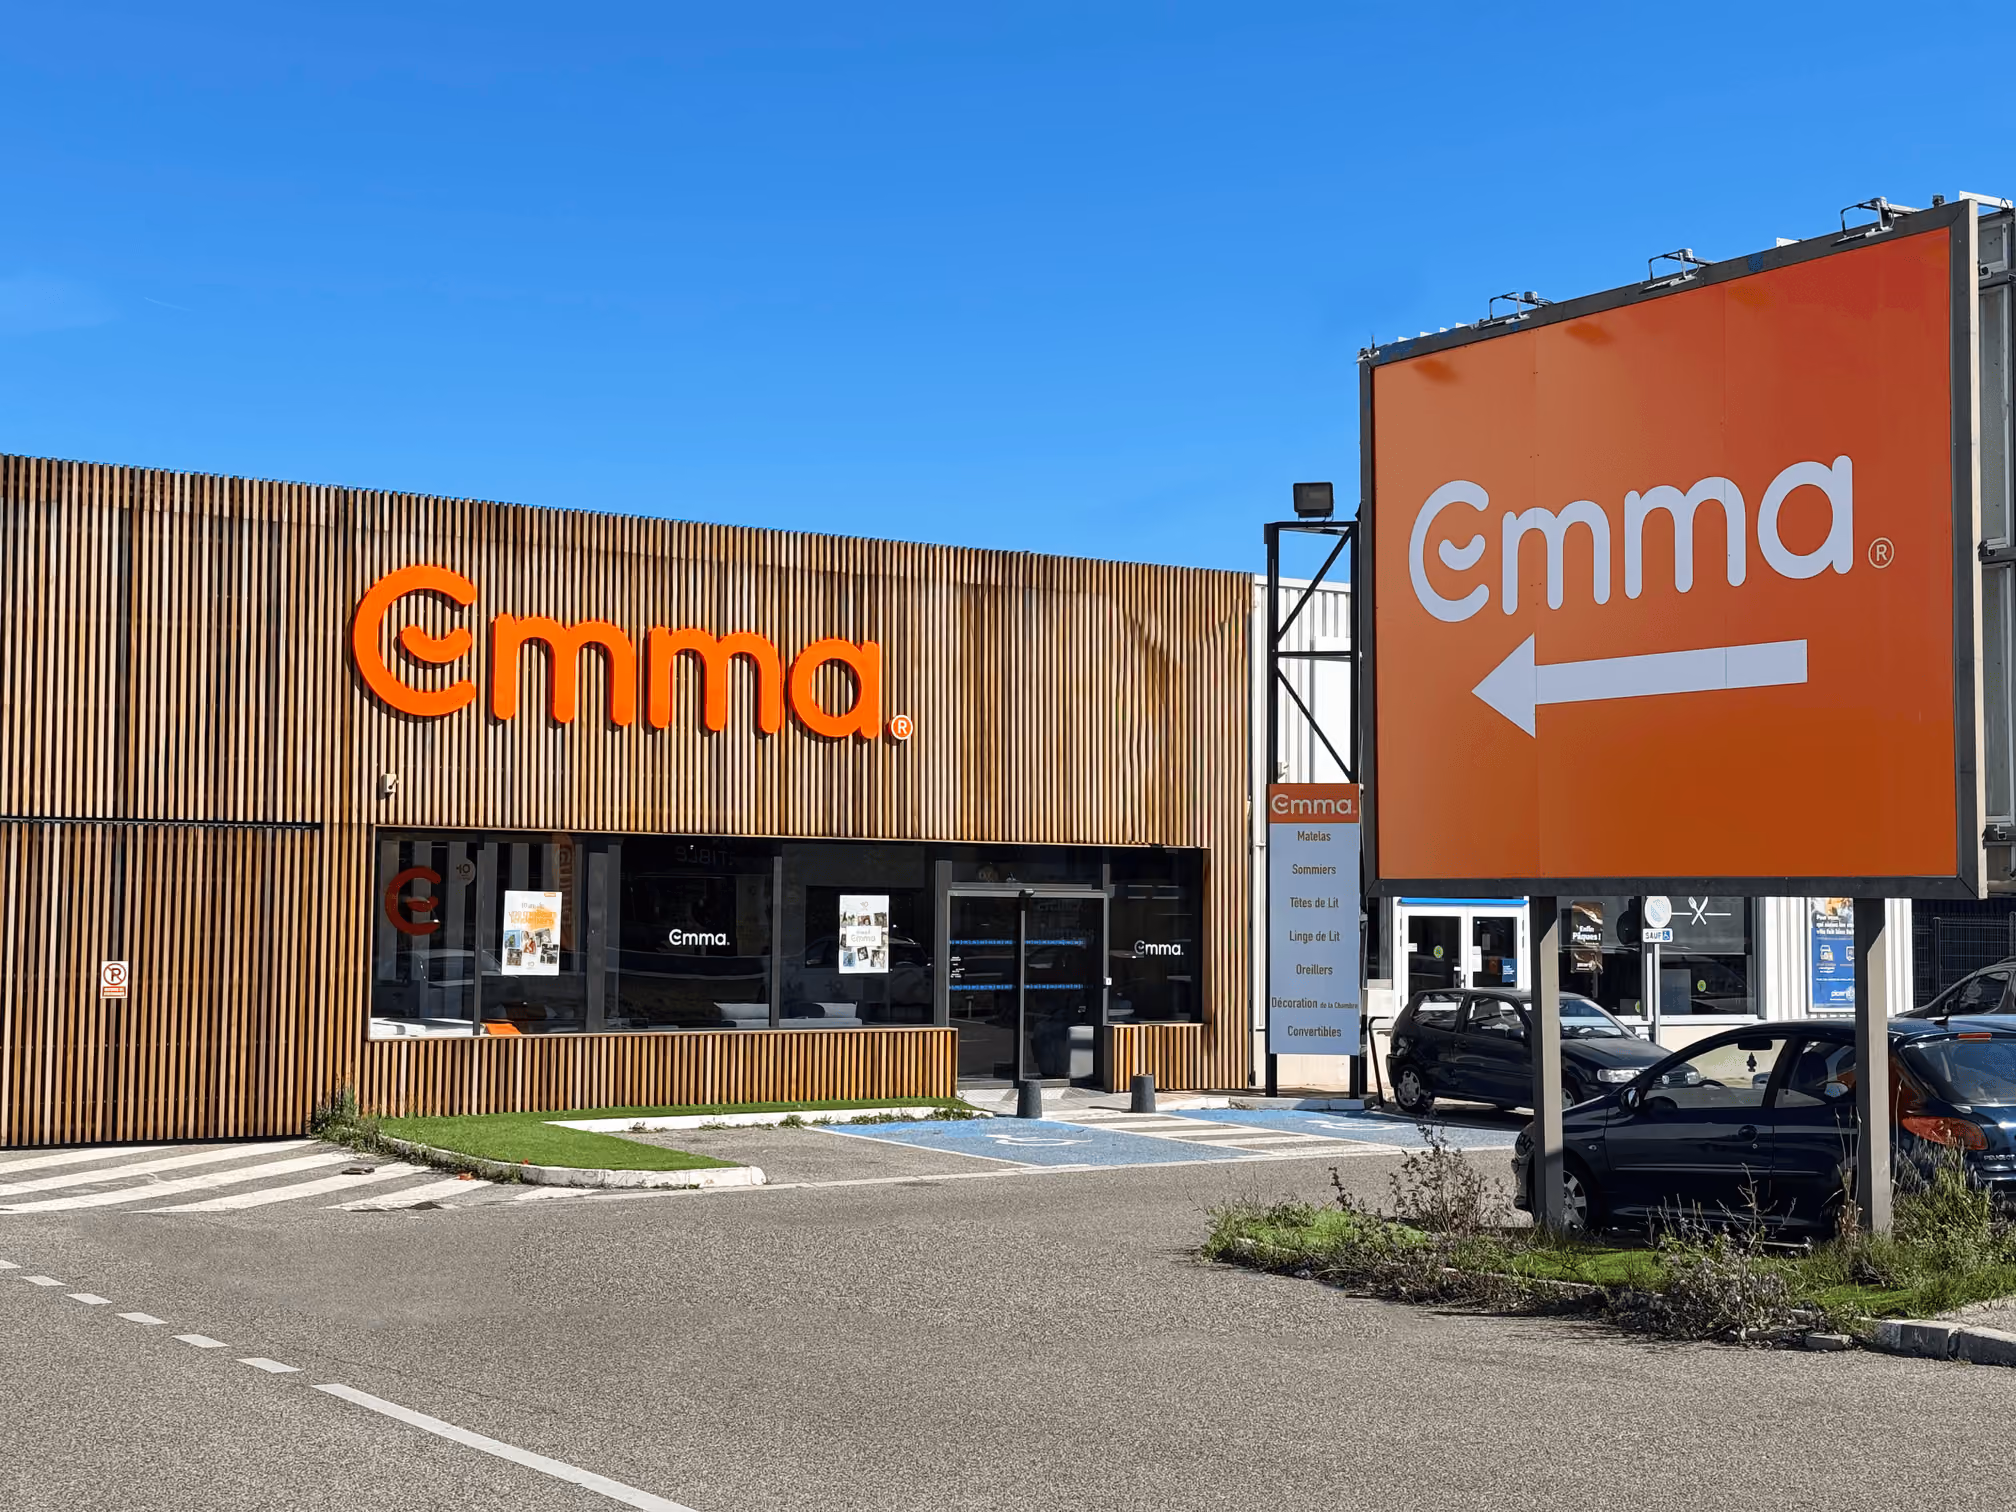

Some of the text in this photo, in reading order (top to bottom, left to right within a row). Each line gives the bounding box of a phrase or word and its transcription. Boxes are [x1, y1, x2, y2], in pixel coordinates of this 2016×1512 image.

[1409, 455, 1853, 622] Emma
[353, 564, 879, 739] Emma
[1297, 831, 1331, 842] Matelas
[1292, 863, 1336, 875] Sommiers
[1290, 896, 1339, 908] Têtes de Lit
[1289, 930, 1341, 944] Linge de Lit
[1296, 963, 1333, 975] Oreillers
[1271, 997, 1318, 1009] Décoration
[1287, 1025, 1342, 1038] Convertibles
